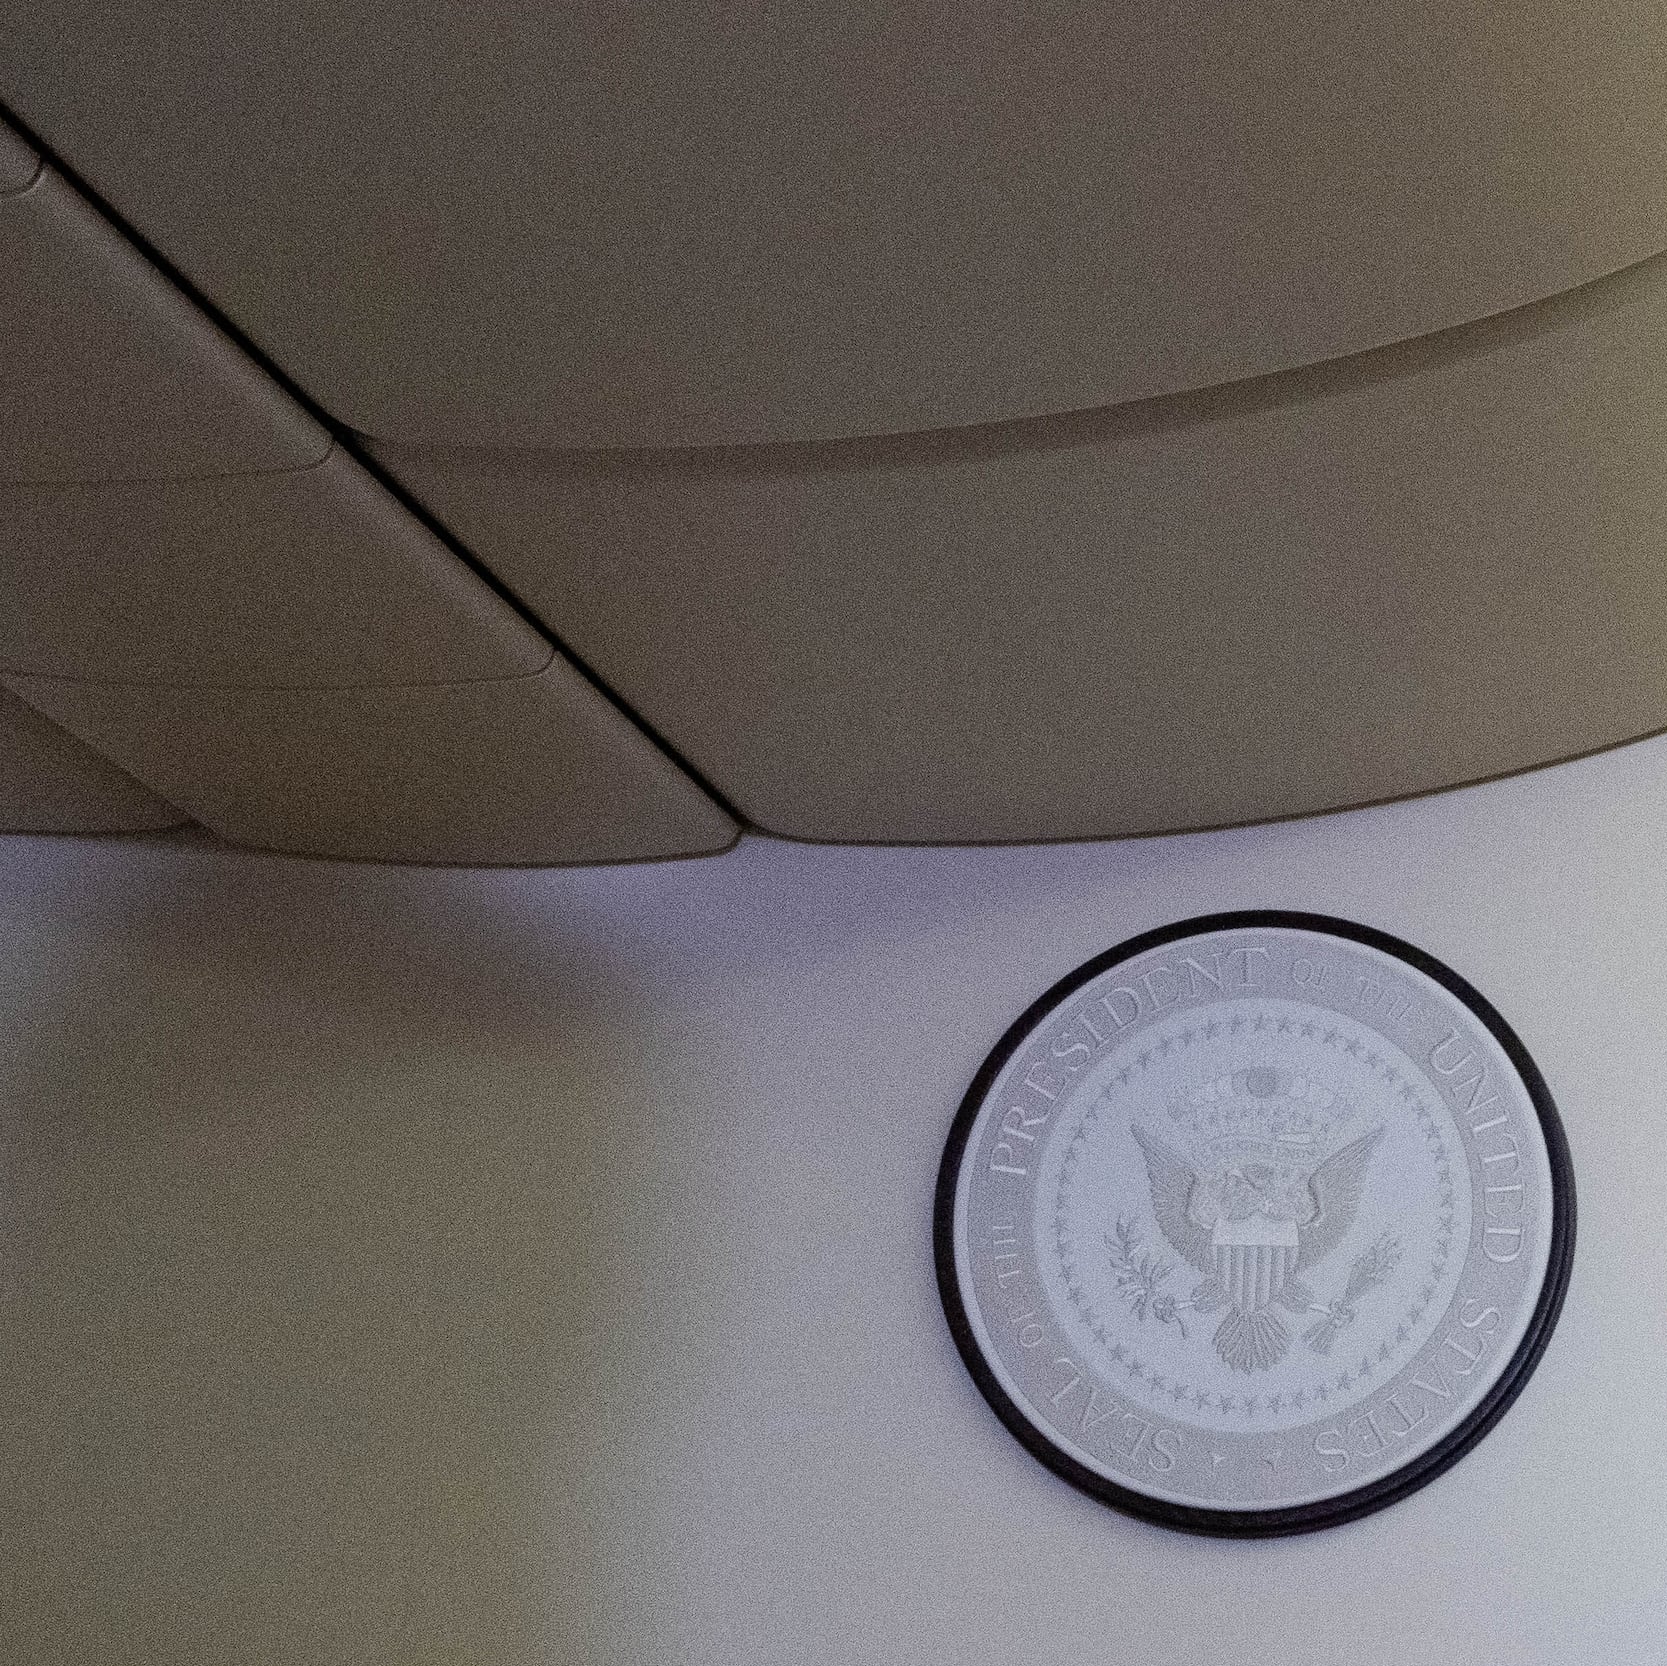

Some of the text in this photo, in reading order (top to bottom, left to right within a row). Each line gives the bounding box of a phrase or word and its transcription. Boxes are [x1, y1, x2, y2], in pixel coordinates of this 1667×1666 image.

[989, 946, 1269, 1175] PRESIDENT
[1430, 1027, 1525, 1263] UNITED
[1050, 1357, 1181, 1473] SEAL
[1313, 1298, 1500, 1472] STATES
